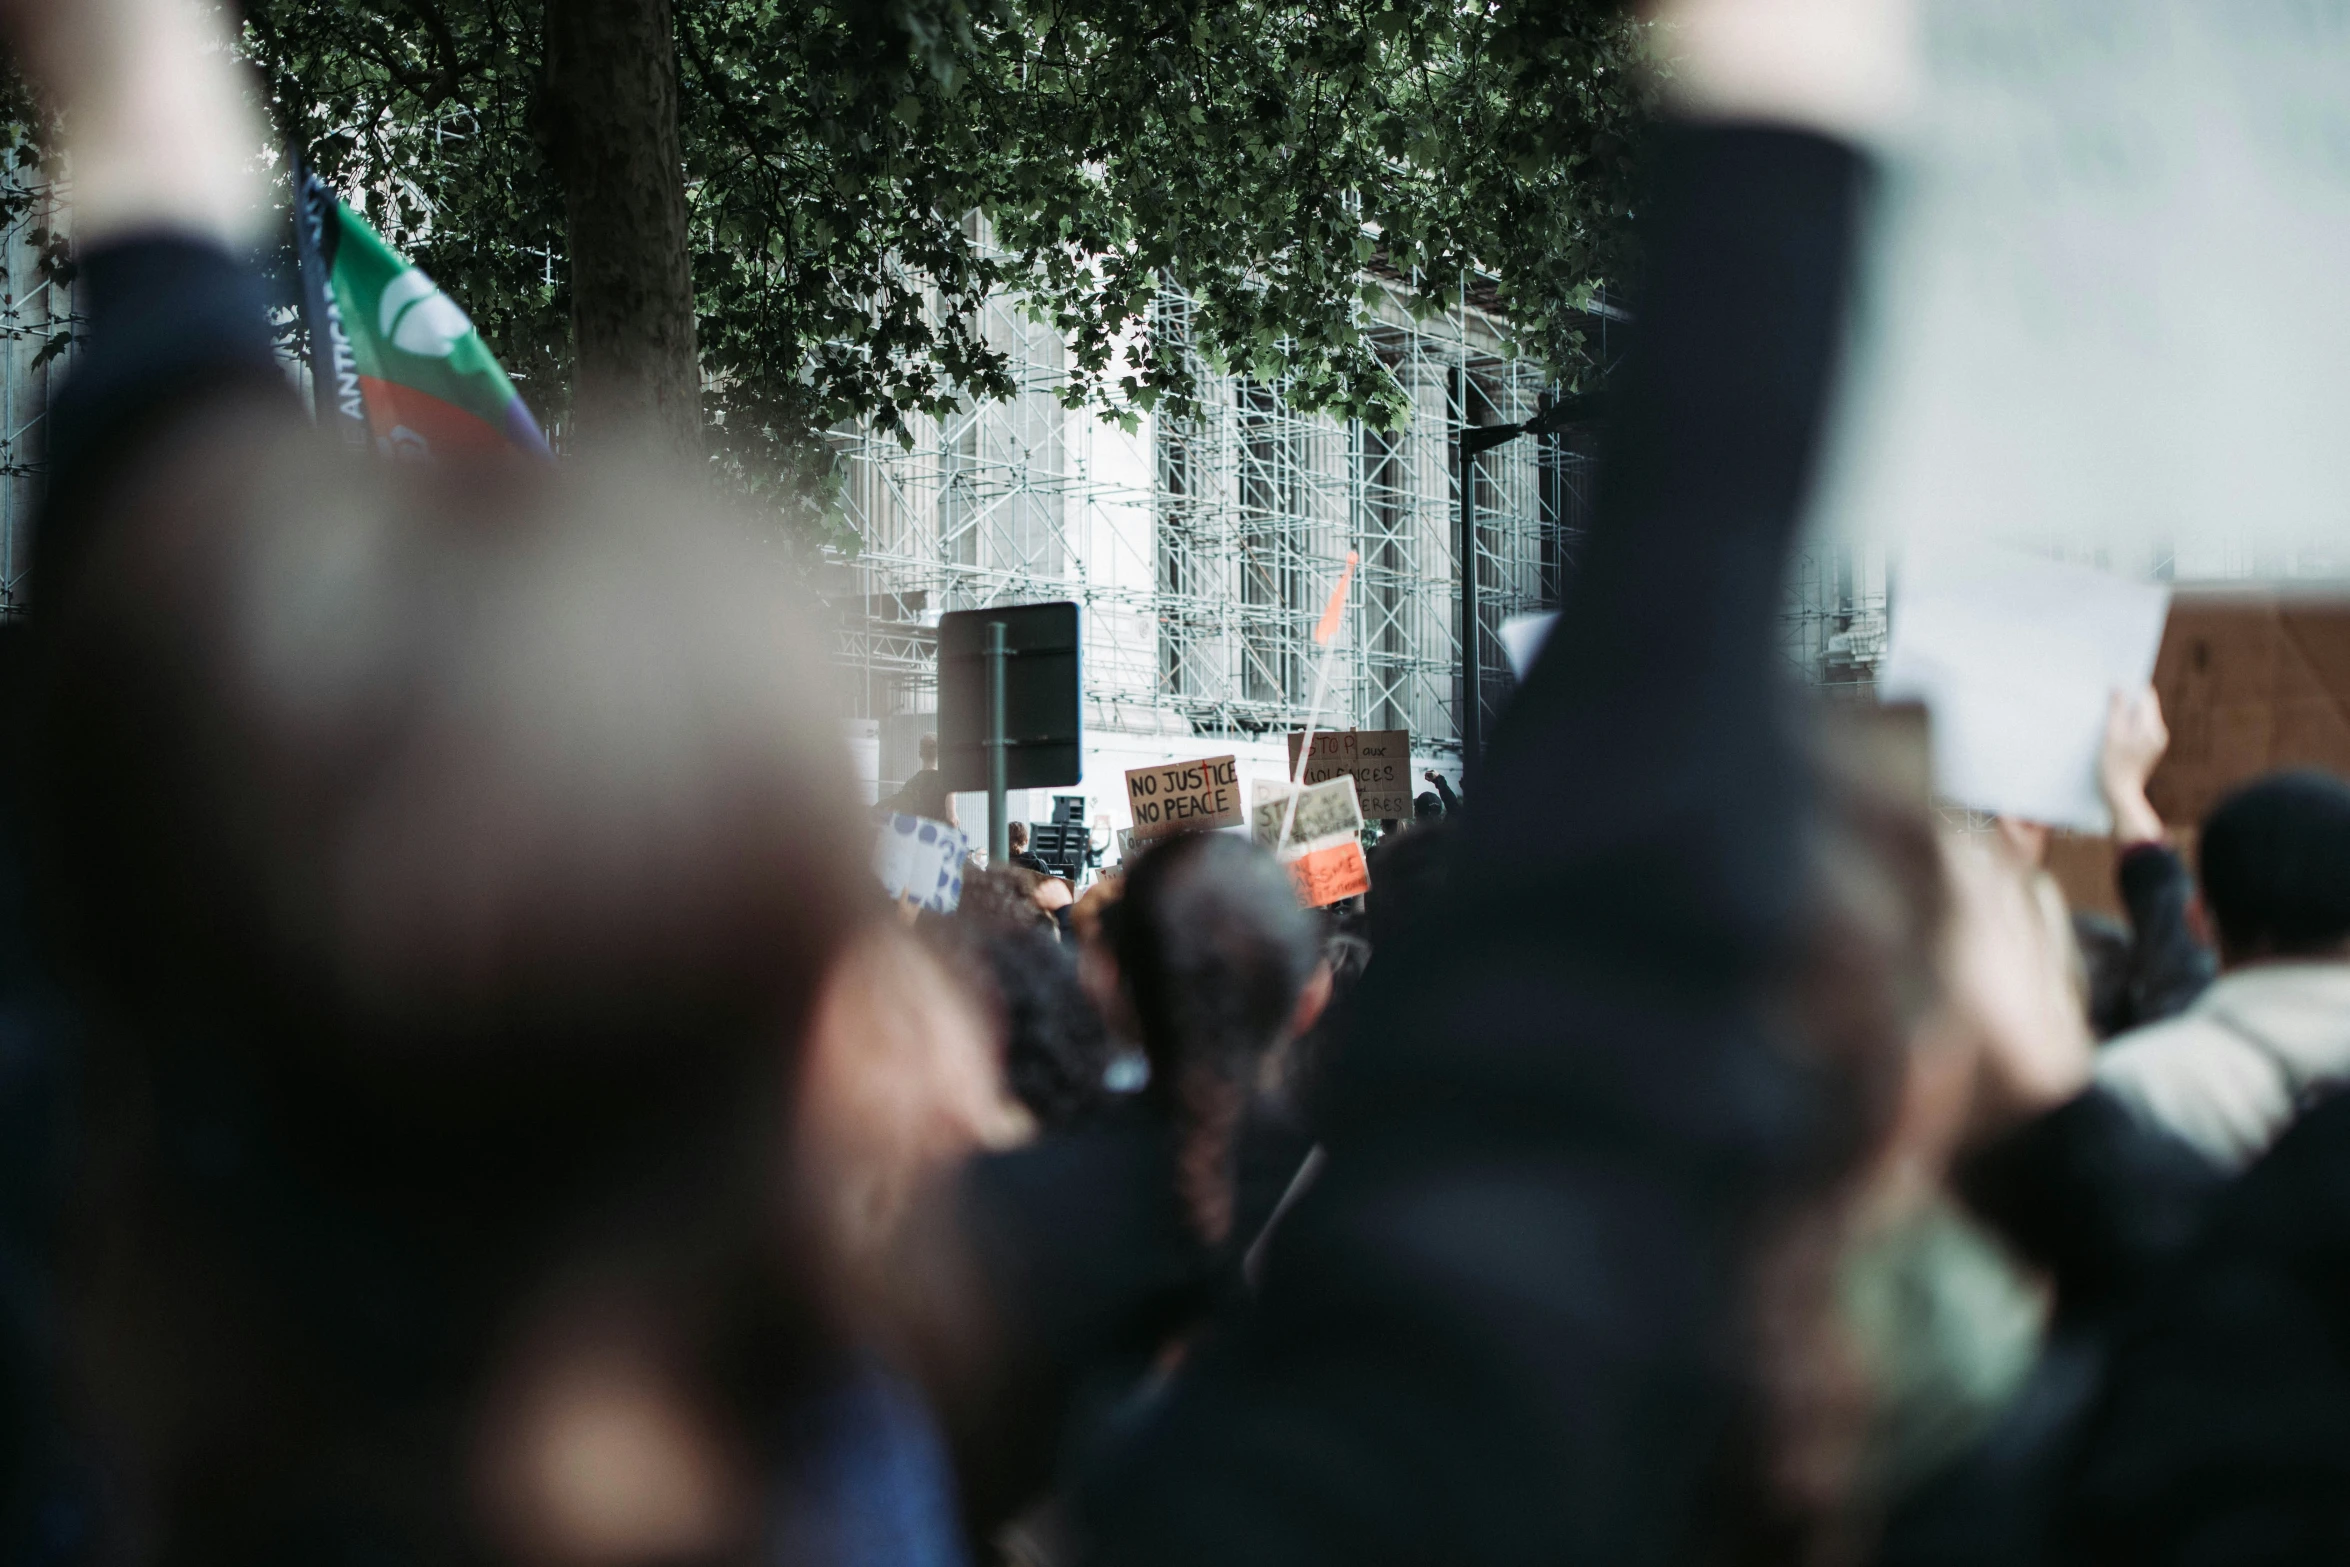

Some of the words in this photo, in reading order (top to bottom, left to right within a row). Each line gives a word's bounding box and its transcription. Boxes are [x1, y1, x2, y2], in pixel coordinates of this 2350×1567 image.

[1363, 747, 1387, 756] aux
[1131, 775, 1156, 797] NO
[1163, 761, 1237, 793] JUSTICE
[1136, 802, 1159, 825] NO
[1164, 789, 1230, 821] PEACE
